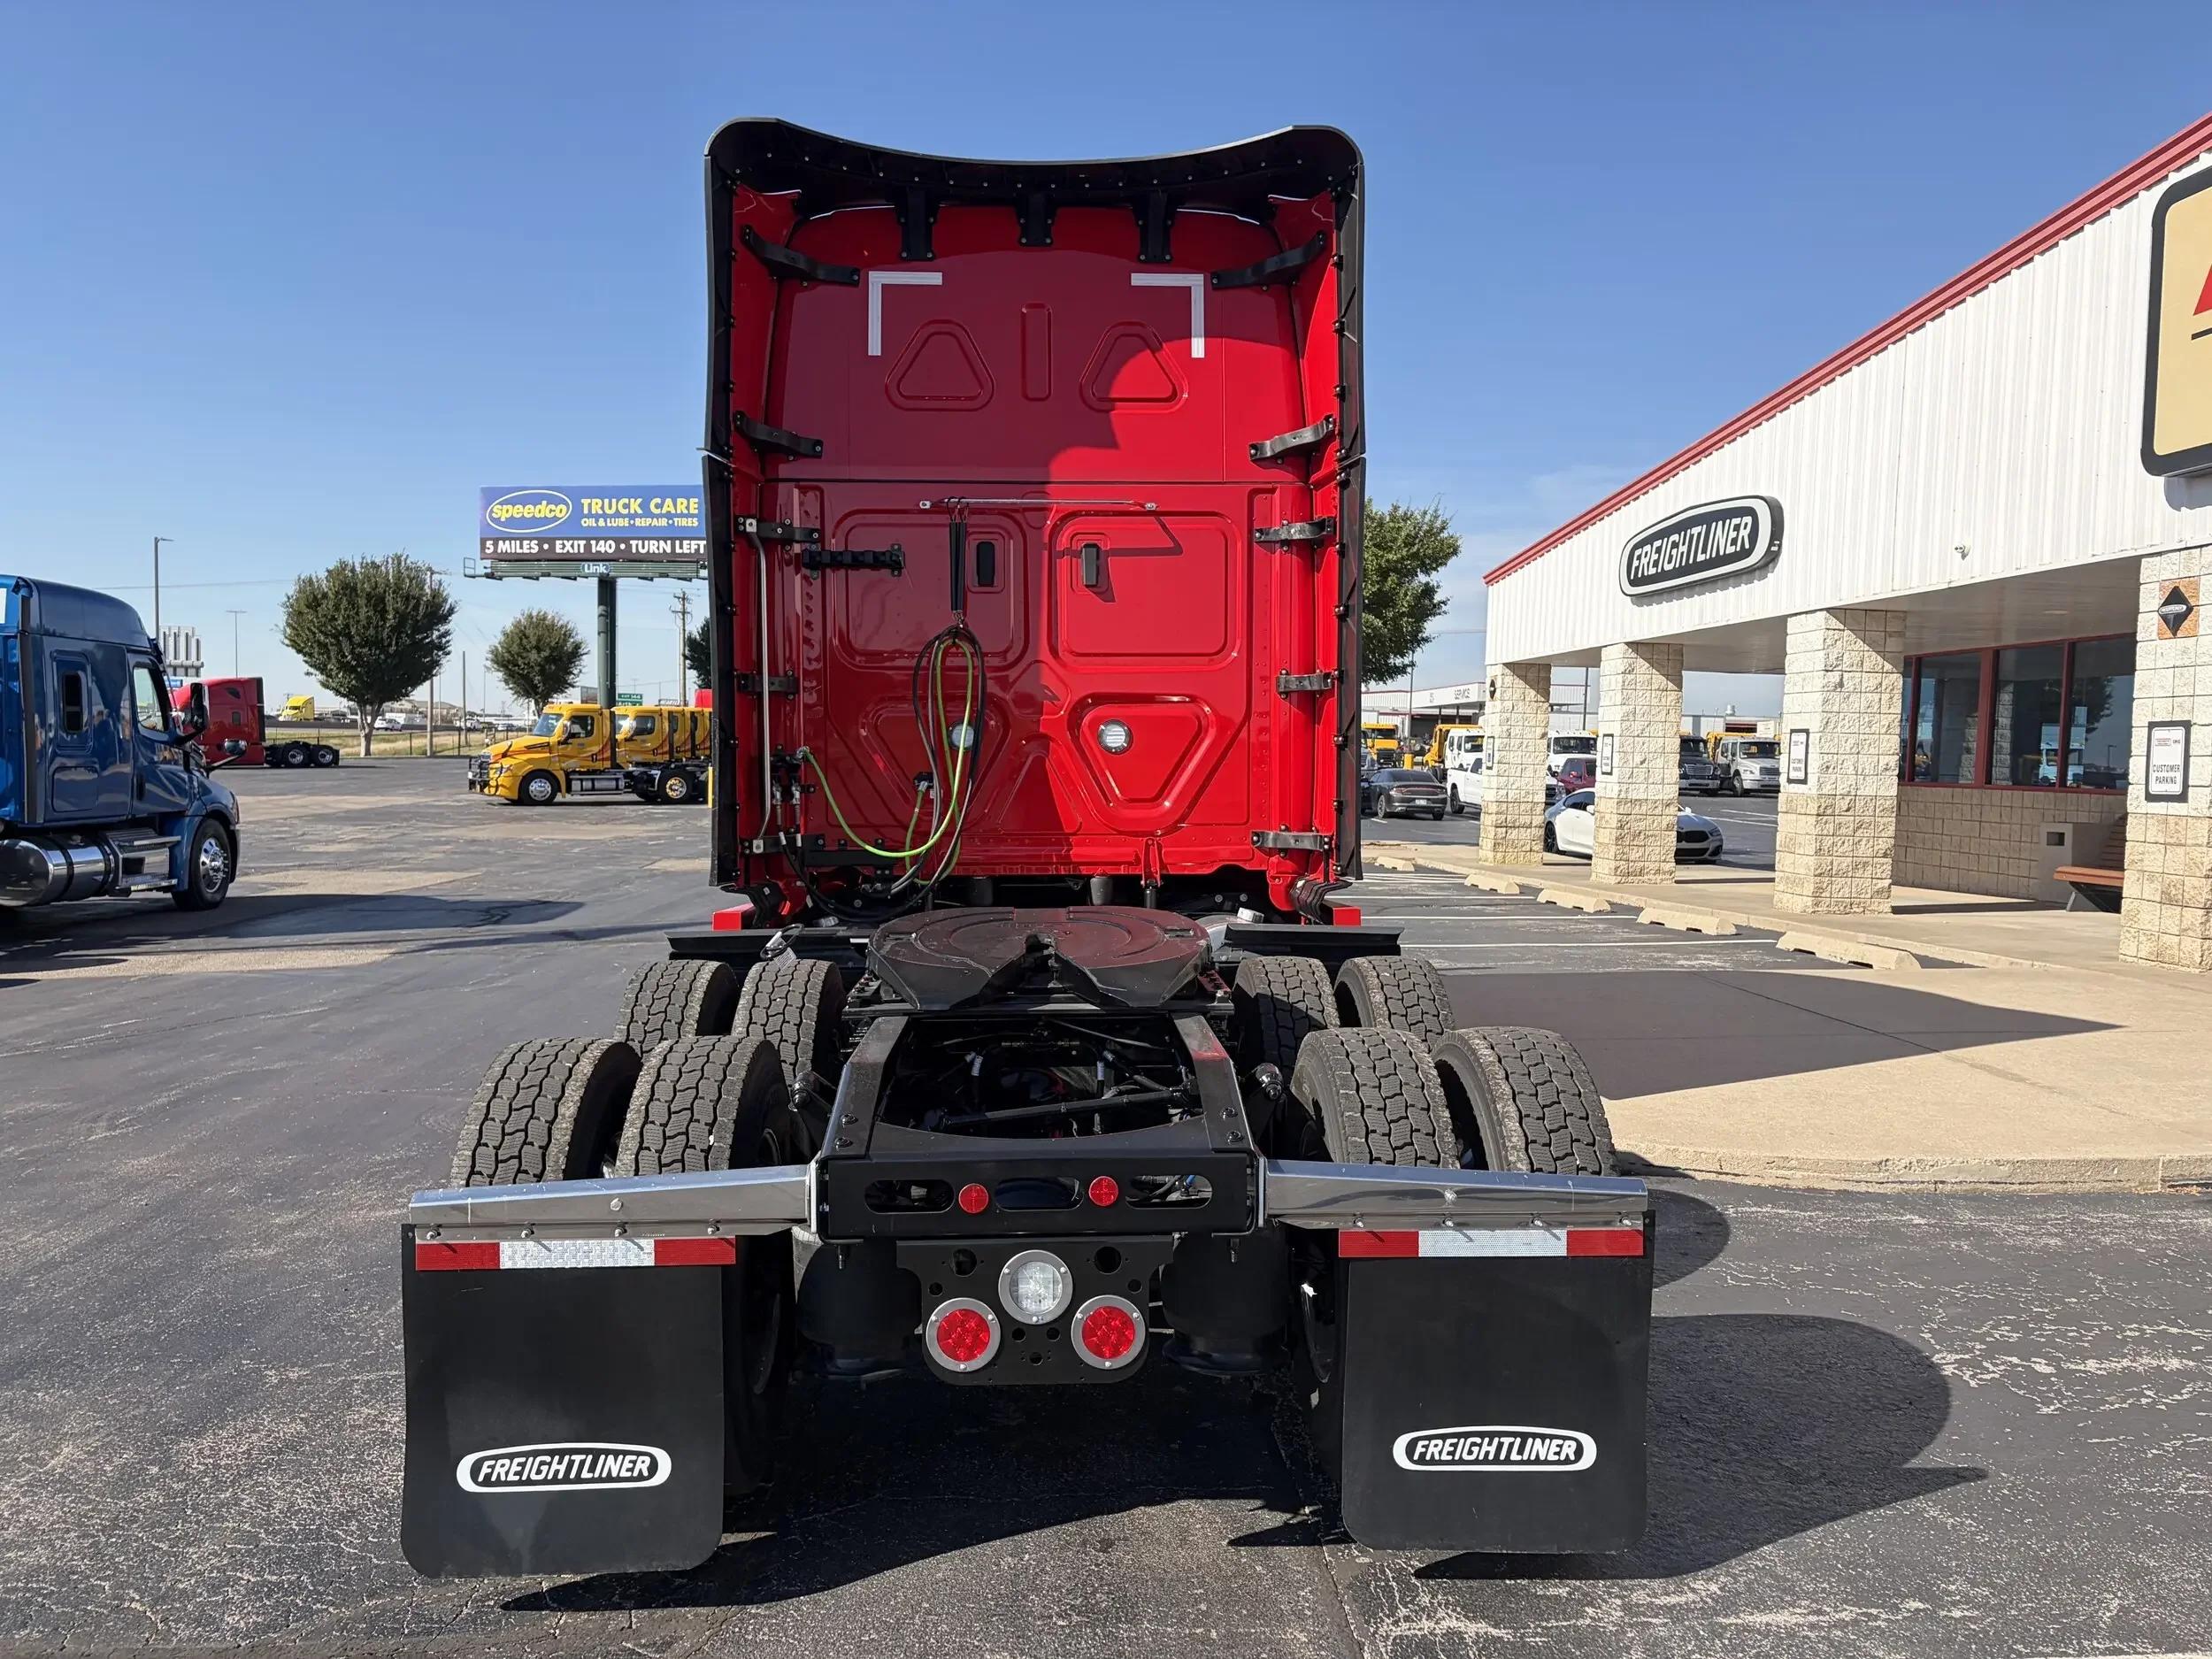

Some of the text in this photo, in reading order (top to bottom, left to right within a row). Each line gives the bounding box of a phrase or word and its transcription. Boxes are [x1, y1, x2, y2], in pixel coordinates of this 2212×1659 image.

[492, 500, 567, 521] speedco
[580, 497, 699, 514] TRUCK CARE
[580, 518, 699, 527] OIL & LUBE REPAIR TIRES
[485, 540, 706, 554] 5 MILES EXIT 140 TURN LEFT
[1630, 516, 1753, 580] FREIGHTLINER
[584, 564, 607, 573] Link
[2152, 764, 2181, 773] CUSTOMER
[2154, 775, 2177, 785] PARKING
[1413, 1436, 1577, 1461] FREIGHTLINER
[477, 1454, 651, 1482] FREIGHTLINER
